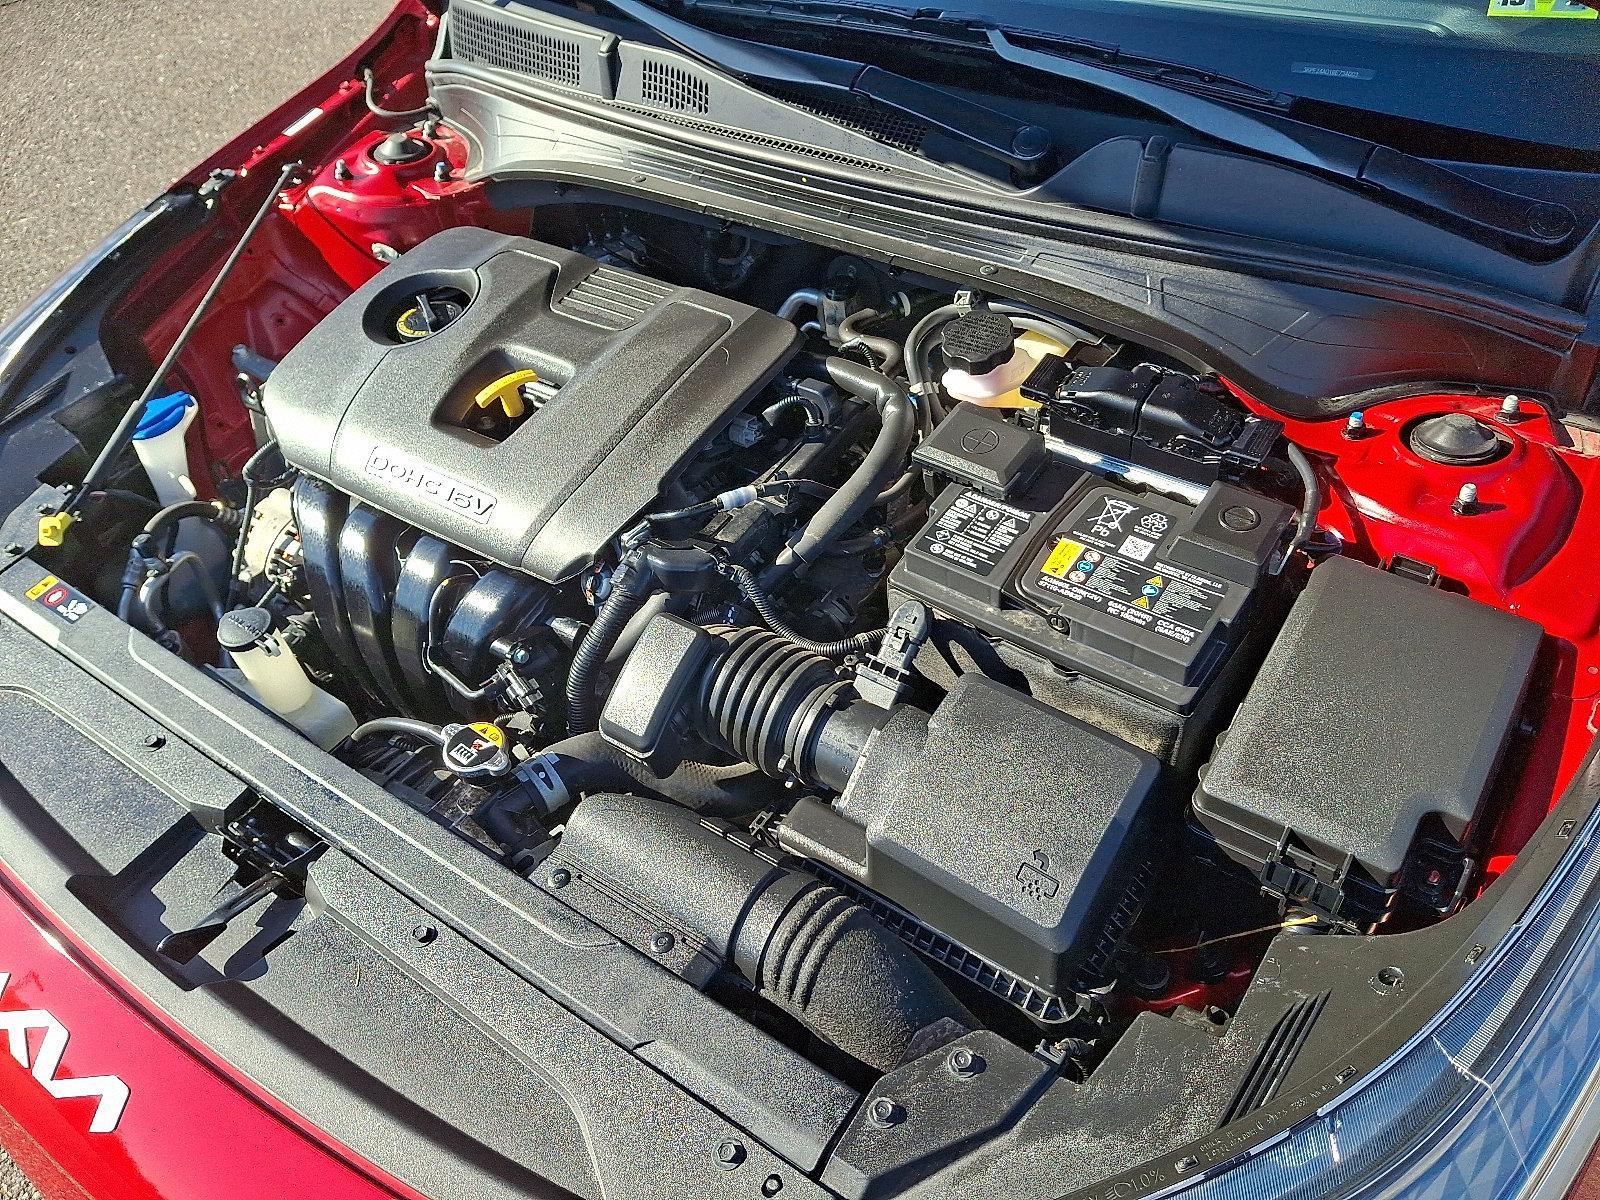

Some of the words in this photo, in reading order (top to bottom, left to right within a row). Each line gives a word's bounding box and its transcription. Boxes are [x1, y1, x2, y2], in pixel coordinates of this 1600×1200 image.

[371, 456, 442, 495] DOHC
[1091, 525, 1110, 537] Pb
[1157, 620, 1174, 630] CCA
